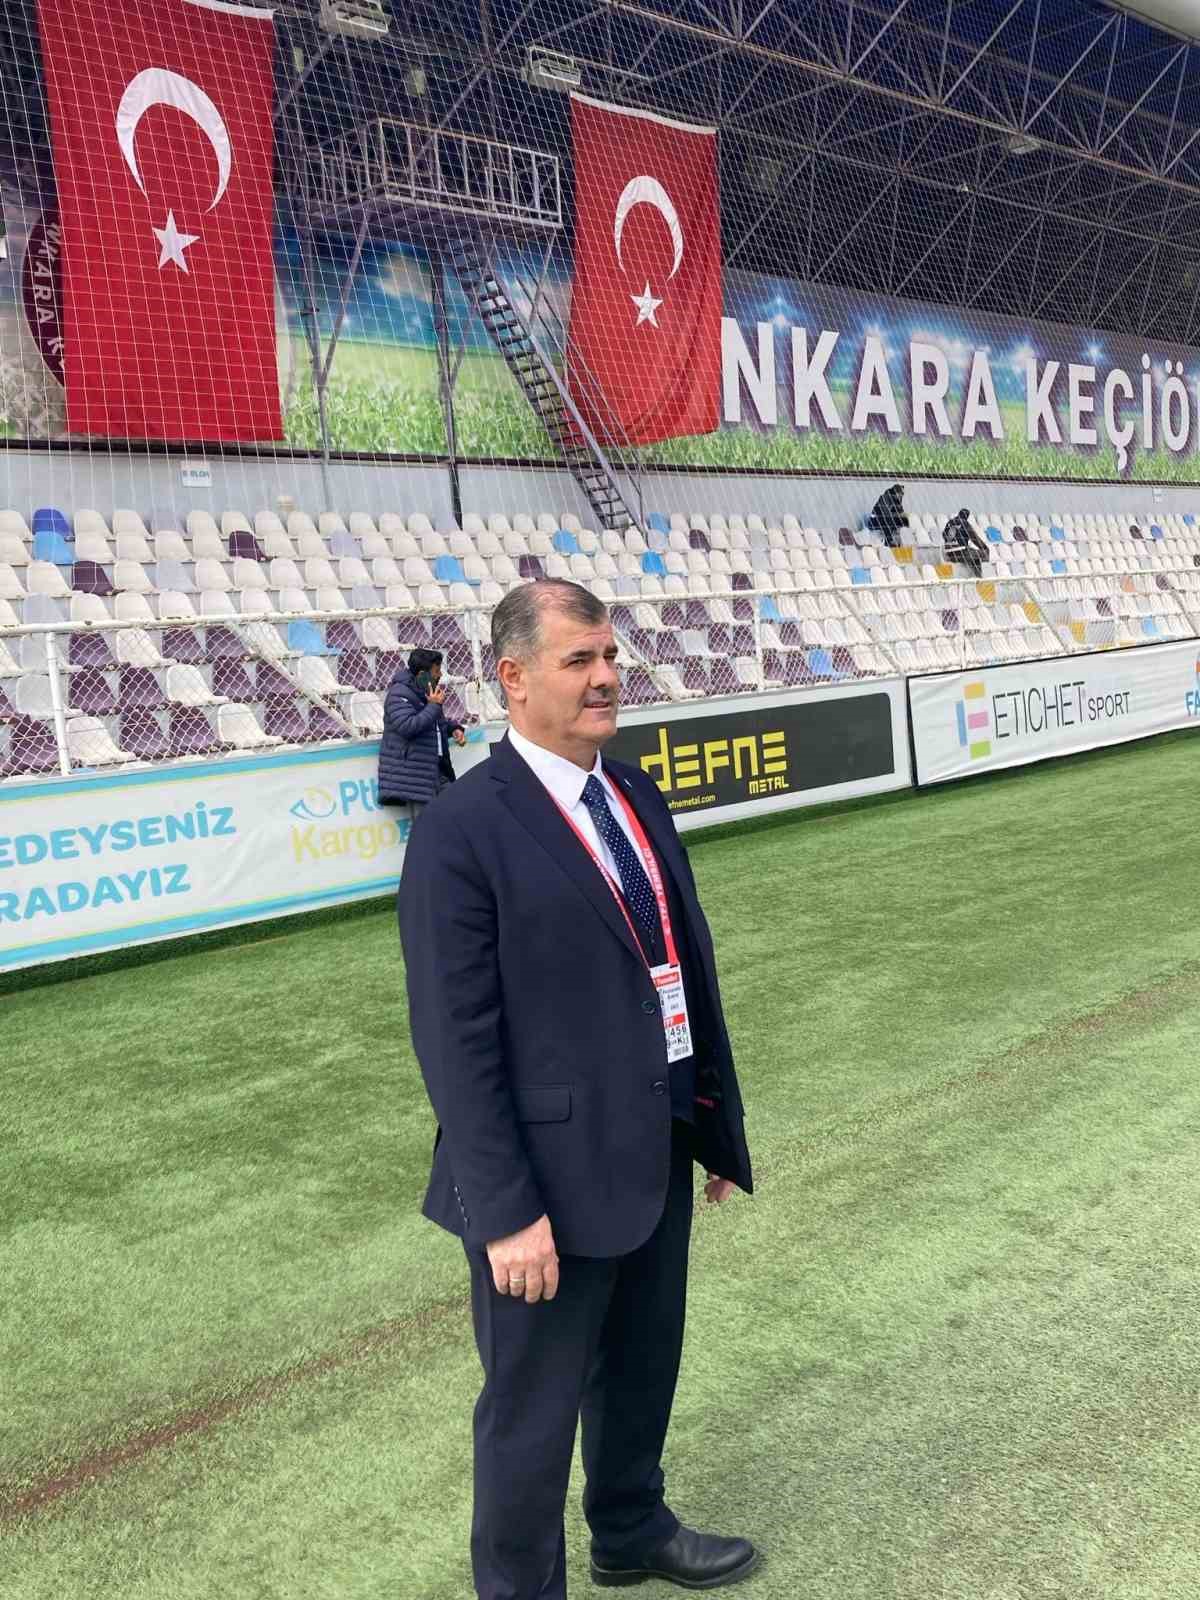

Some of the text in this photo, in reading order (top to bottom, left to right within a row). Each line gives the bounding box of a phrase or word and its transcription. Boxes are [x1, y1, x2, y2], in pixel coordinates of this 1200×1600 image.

[1027, 353, 1200, 472] KEÇİÖ
[992, 680, 1131, 739] ETICHET SPORT
[292, 819, 397, 864] Kargo
